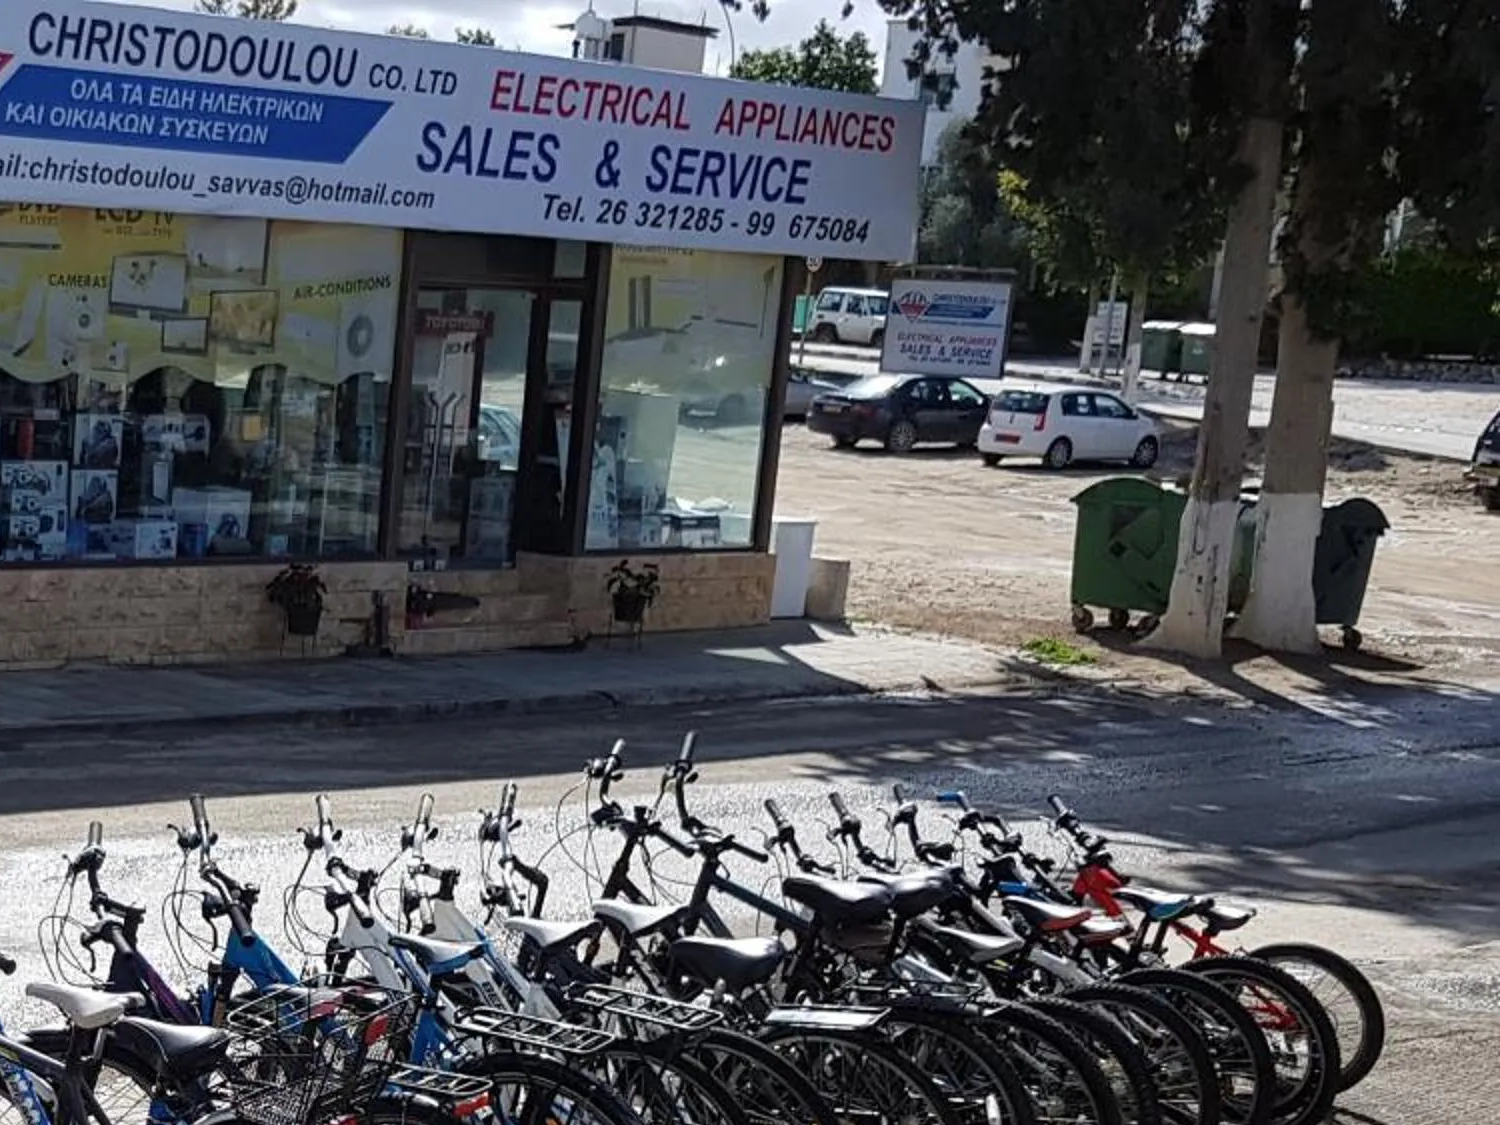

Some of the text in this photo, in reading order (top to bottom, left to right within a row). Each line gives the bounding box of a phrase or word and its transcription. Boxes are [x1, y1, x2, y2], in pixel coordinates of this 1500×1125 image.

[29, 12, 457, 95] CHRISTODOULOU CO. LTD
[5, 101, 269, 145] ΚΑΙ ΟΙΚΙΑΚΩΝ ΣΥΣΚΕΥΩΝ
[71, 79, 324, 123] ΟΛΑ ΤΑ ΕΙΔΗ ΗΛΕΚΤΡΙΚΩΝ
[490, 69, 896, 151] ELECTRICAL APPLIANCES
[416, 121, 812, 204] SALES & SERVICE
[543, 193, 585, 223] Tel.
[596, 198, 628, 225] 26
[634, 201, 725, 233] 321285
[746, 211, 775, 236] 99
[789, 214, 870, 243] 675084
[49, 273, 108, 289] CAMERAS
